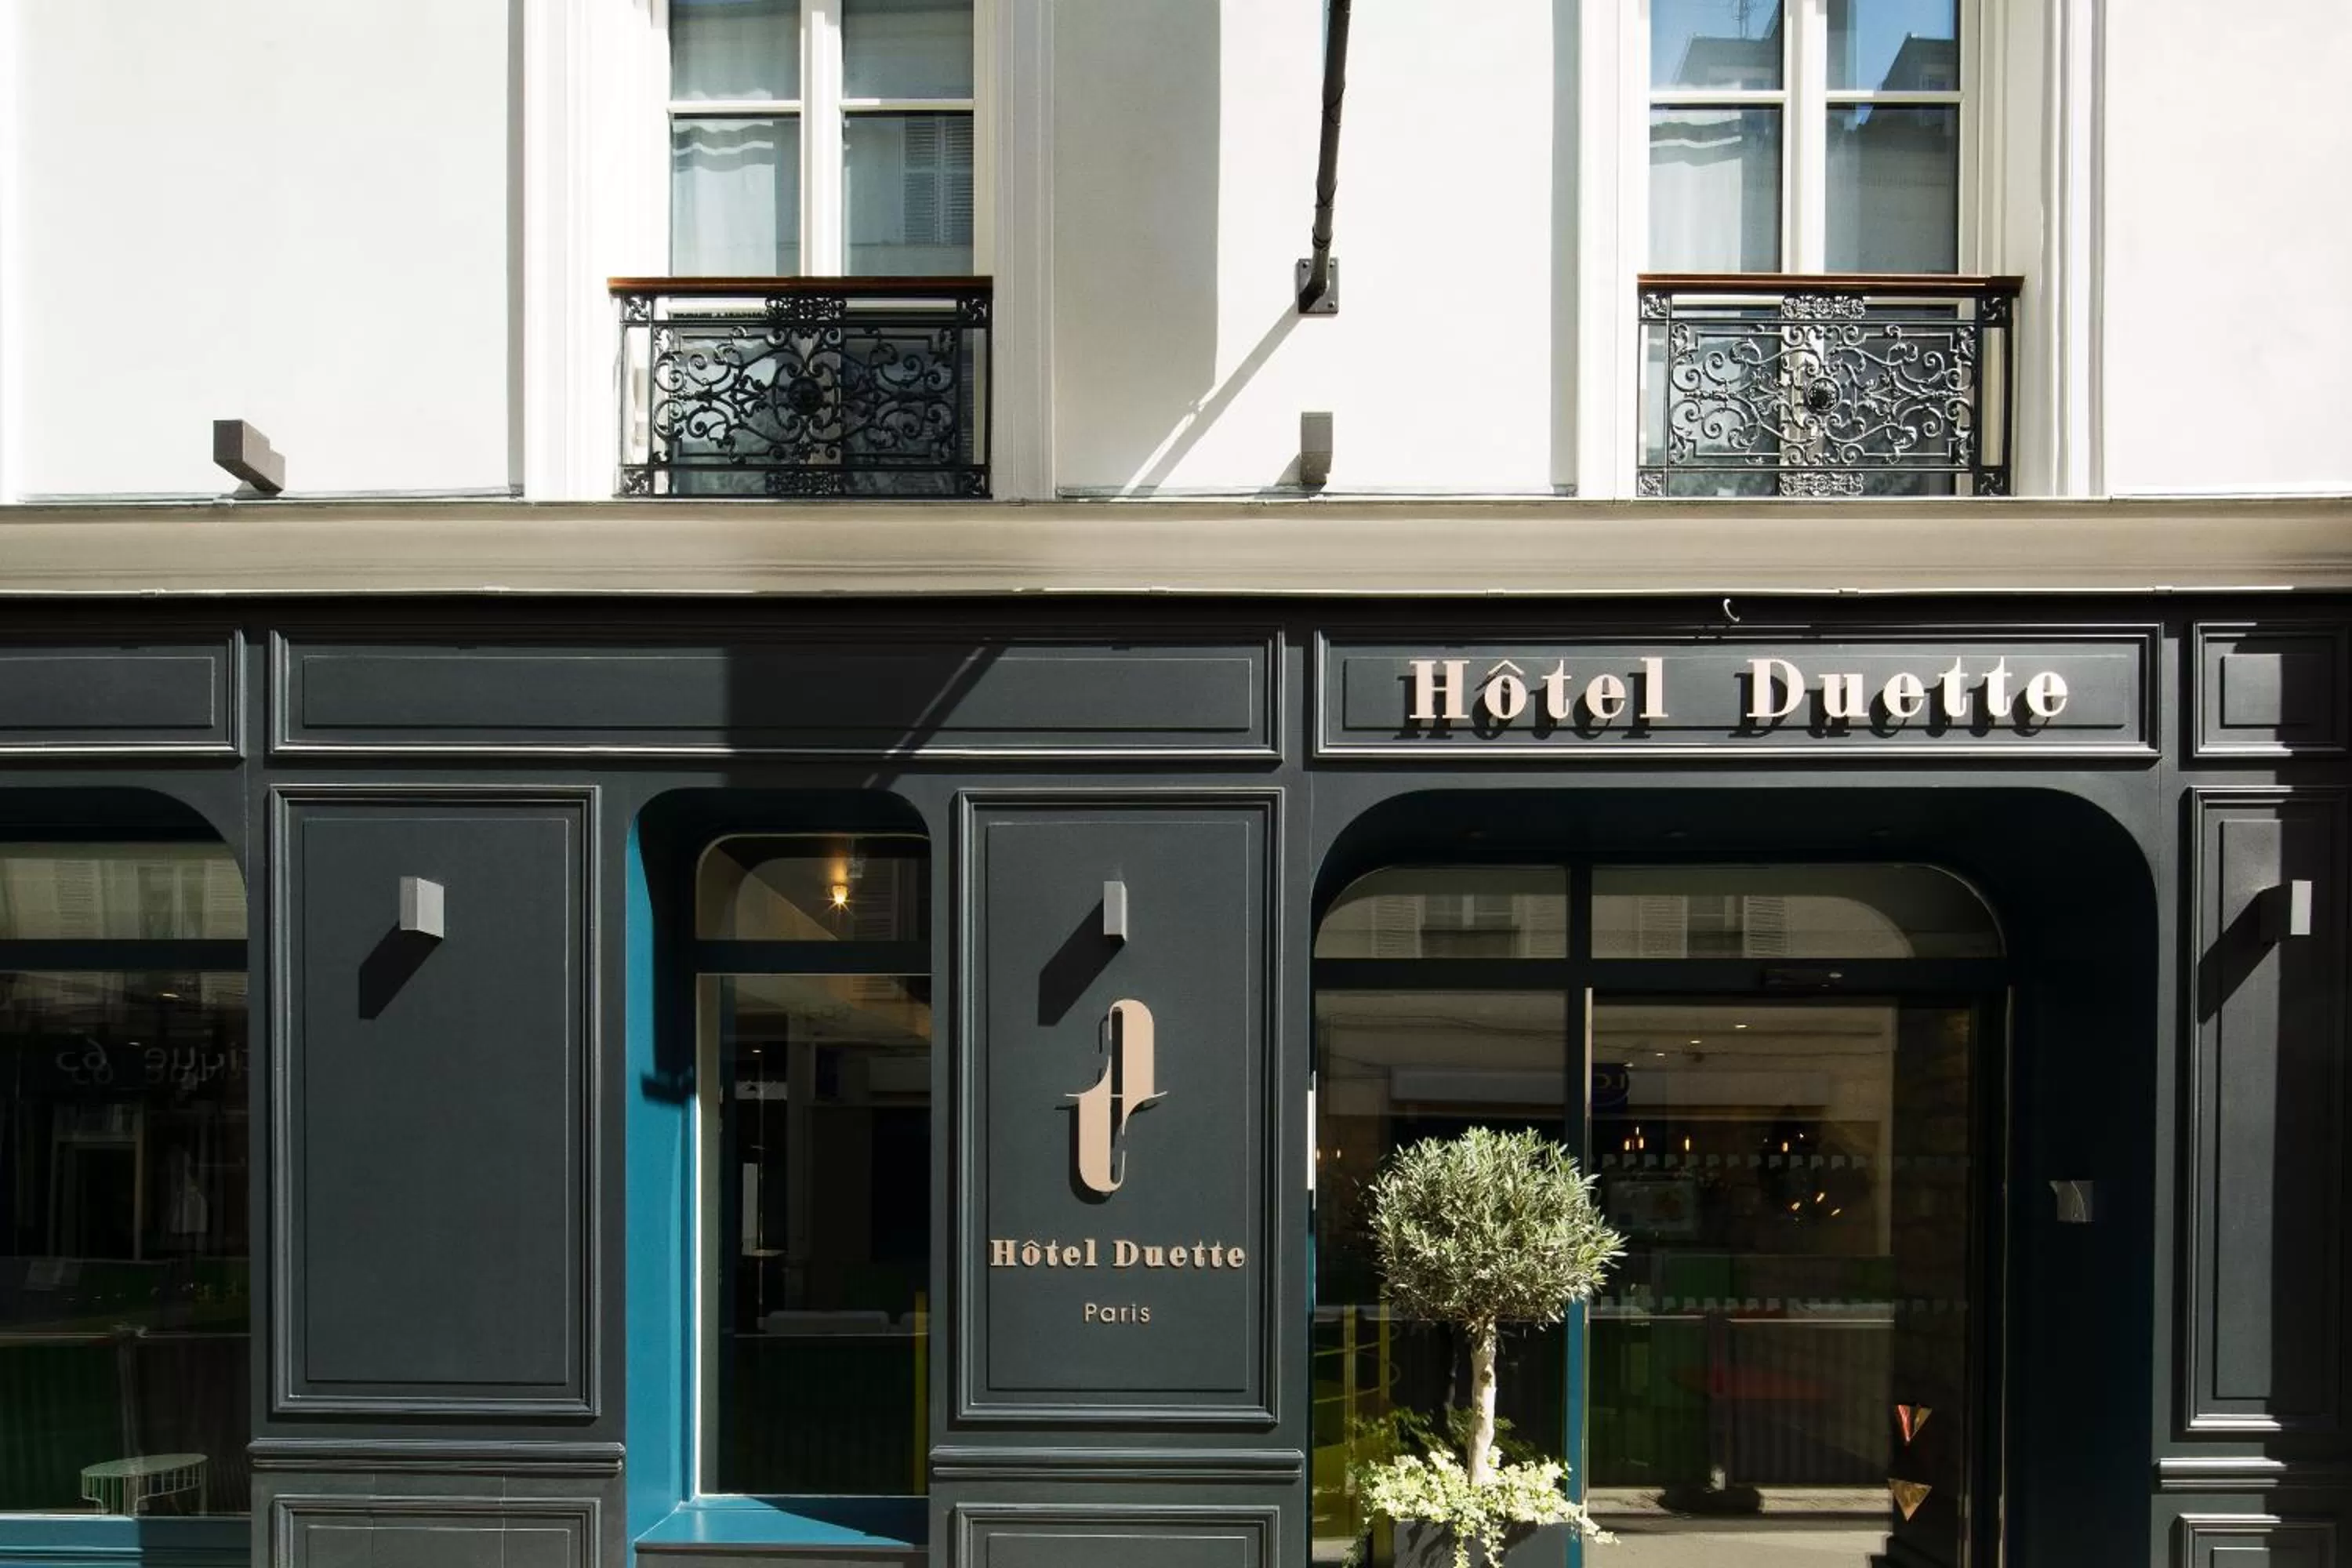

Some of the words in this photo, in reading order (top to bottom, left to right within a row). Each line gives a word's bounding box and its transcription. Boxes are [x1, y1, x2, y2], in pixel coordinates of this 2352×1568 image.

[1409, 657, 1669, 719] Hôtel
[1745, 655, 2069, 718] Duette
[990, 1239, 1098, 1267] Hôtel
[1112, 1240, 1247, 1269] Duette
[1084, 1303, 1152, 1323] Paris
